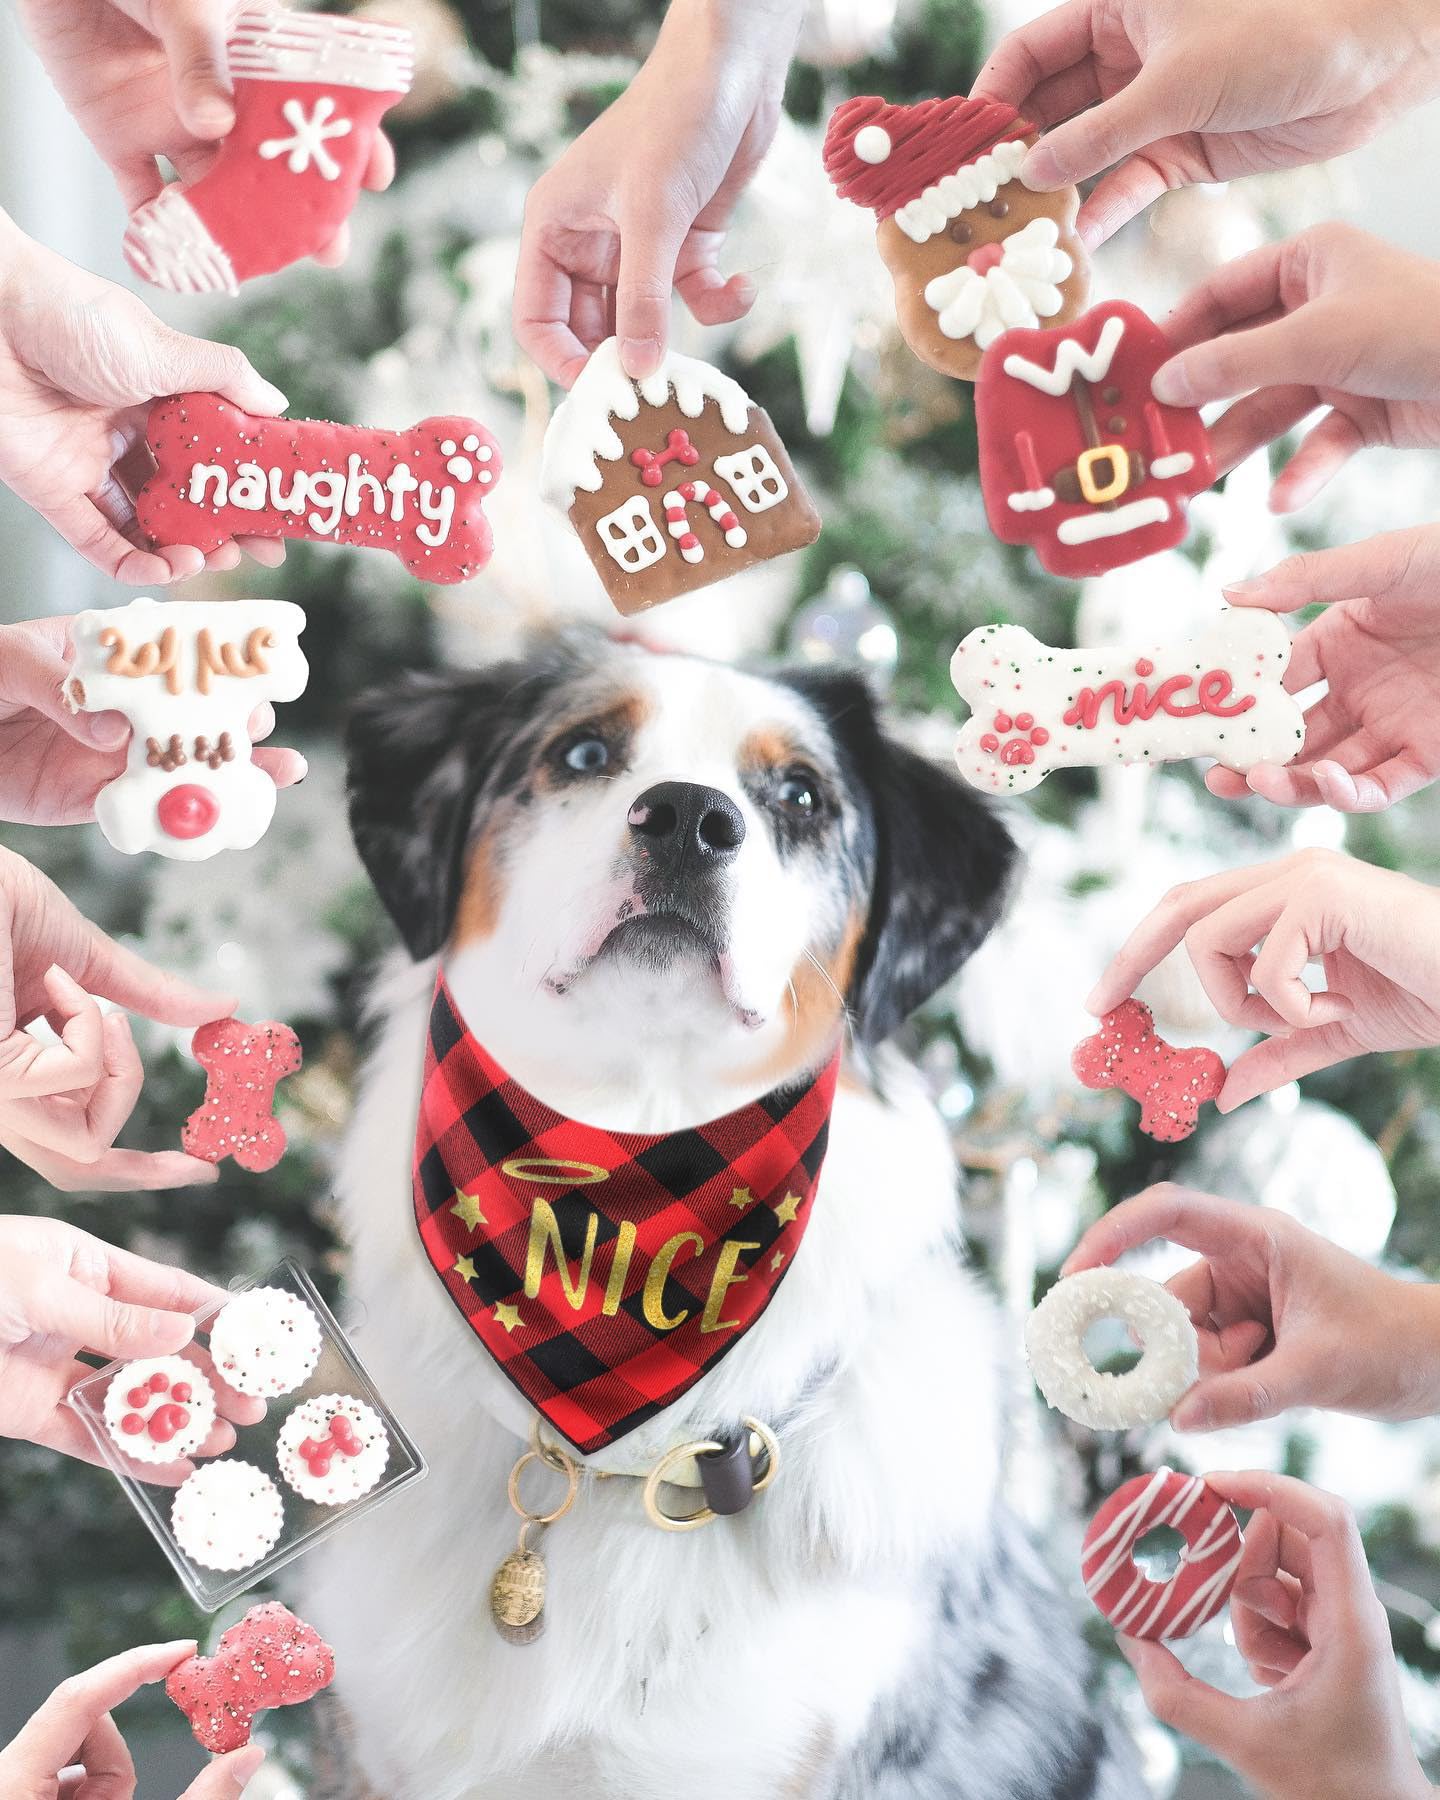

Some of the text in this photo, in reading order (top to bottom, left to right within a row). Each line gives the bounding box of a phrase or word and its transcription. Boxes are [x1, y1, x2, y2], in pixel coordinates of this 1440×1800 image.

[189, 453, 455, 547] naughty
[1063, 658, 1256, 729] nice
[524, 1197, 760, 1333] NICE
